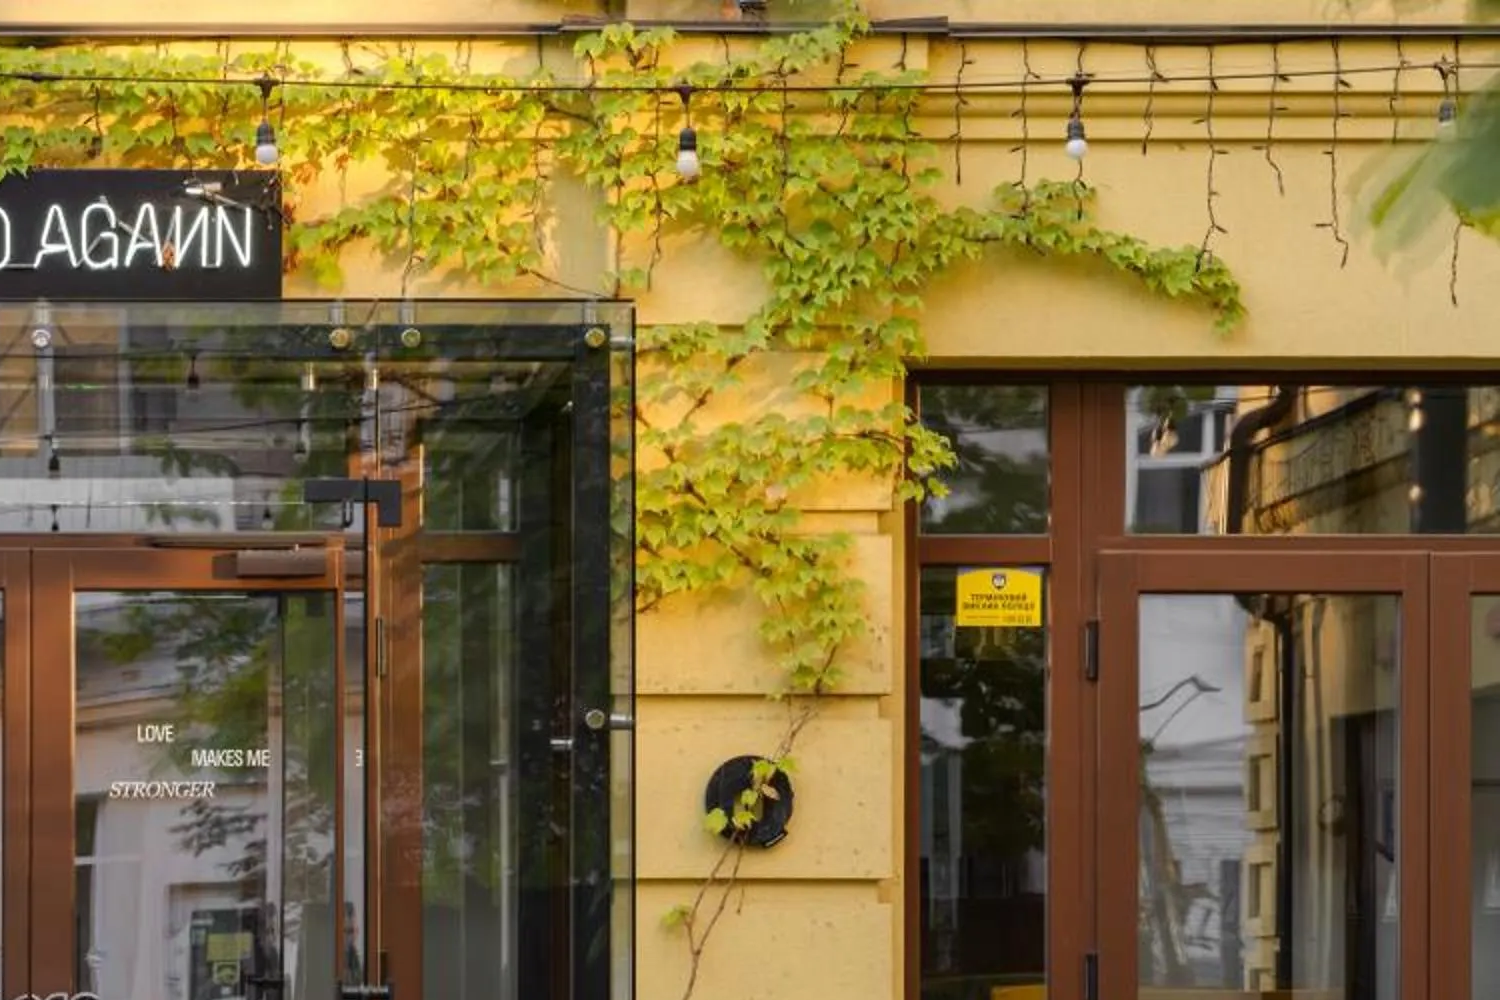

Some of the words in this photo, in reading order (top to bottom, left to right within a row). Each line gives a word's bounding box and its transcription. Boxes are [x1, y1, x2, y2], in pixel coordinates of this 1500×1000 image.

[137, 724, 175, 743] LOVE
[191, 749, 244, 767] MAKES
[247, 749, 271, 767] ME
[109, 781, 216, 800] STRONGER
